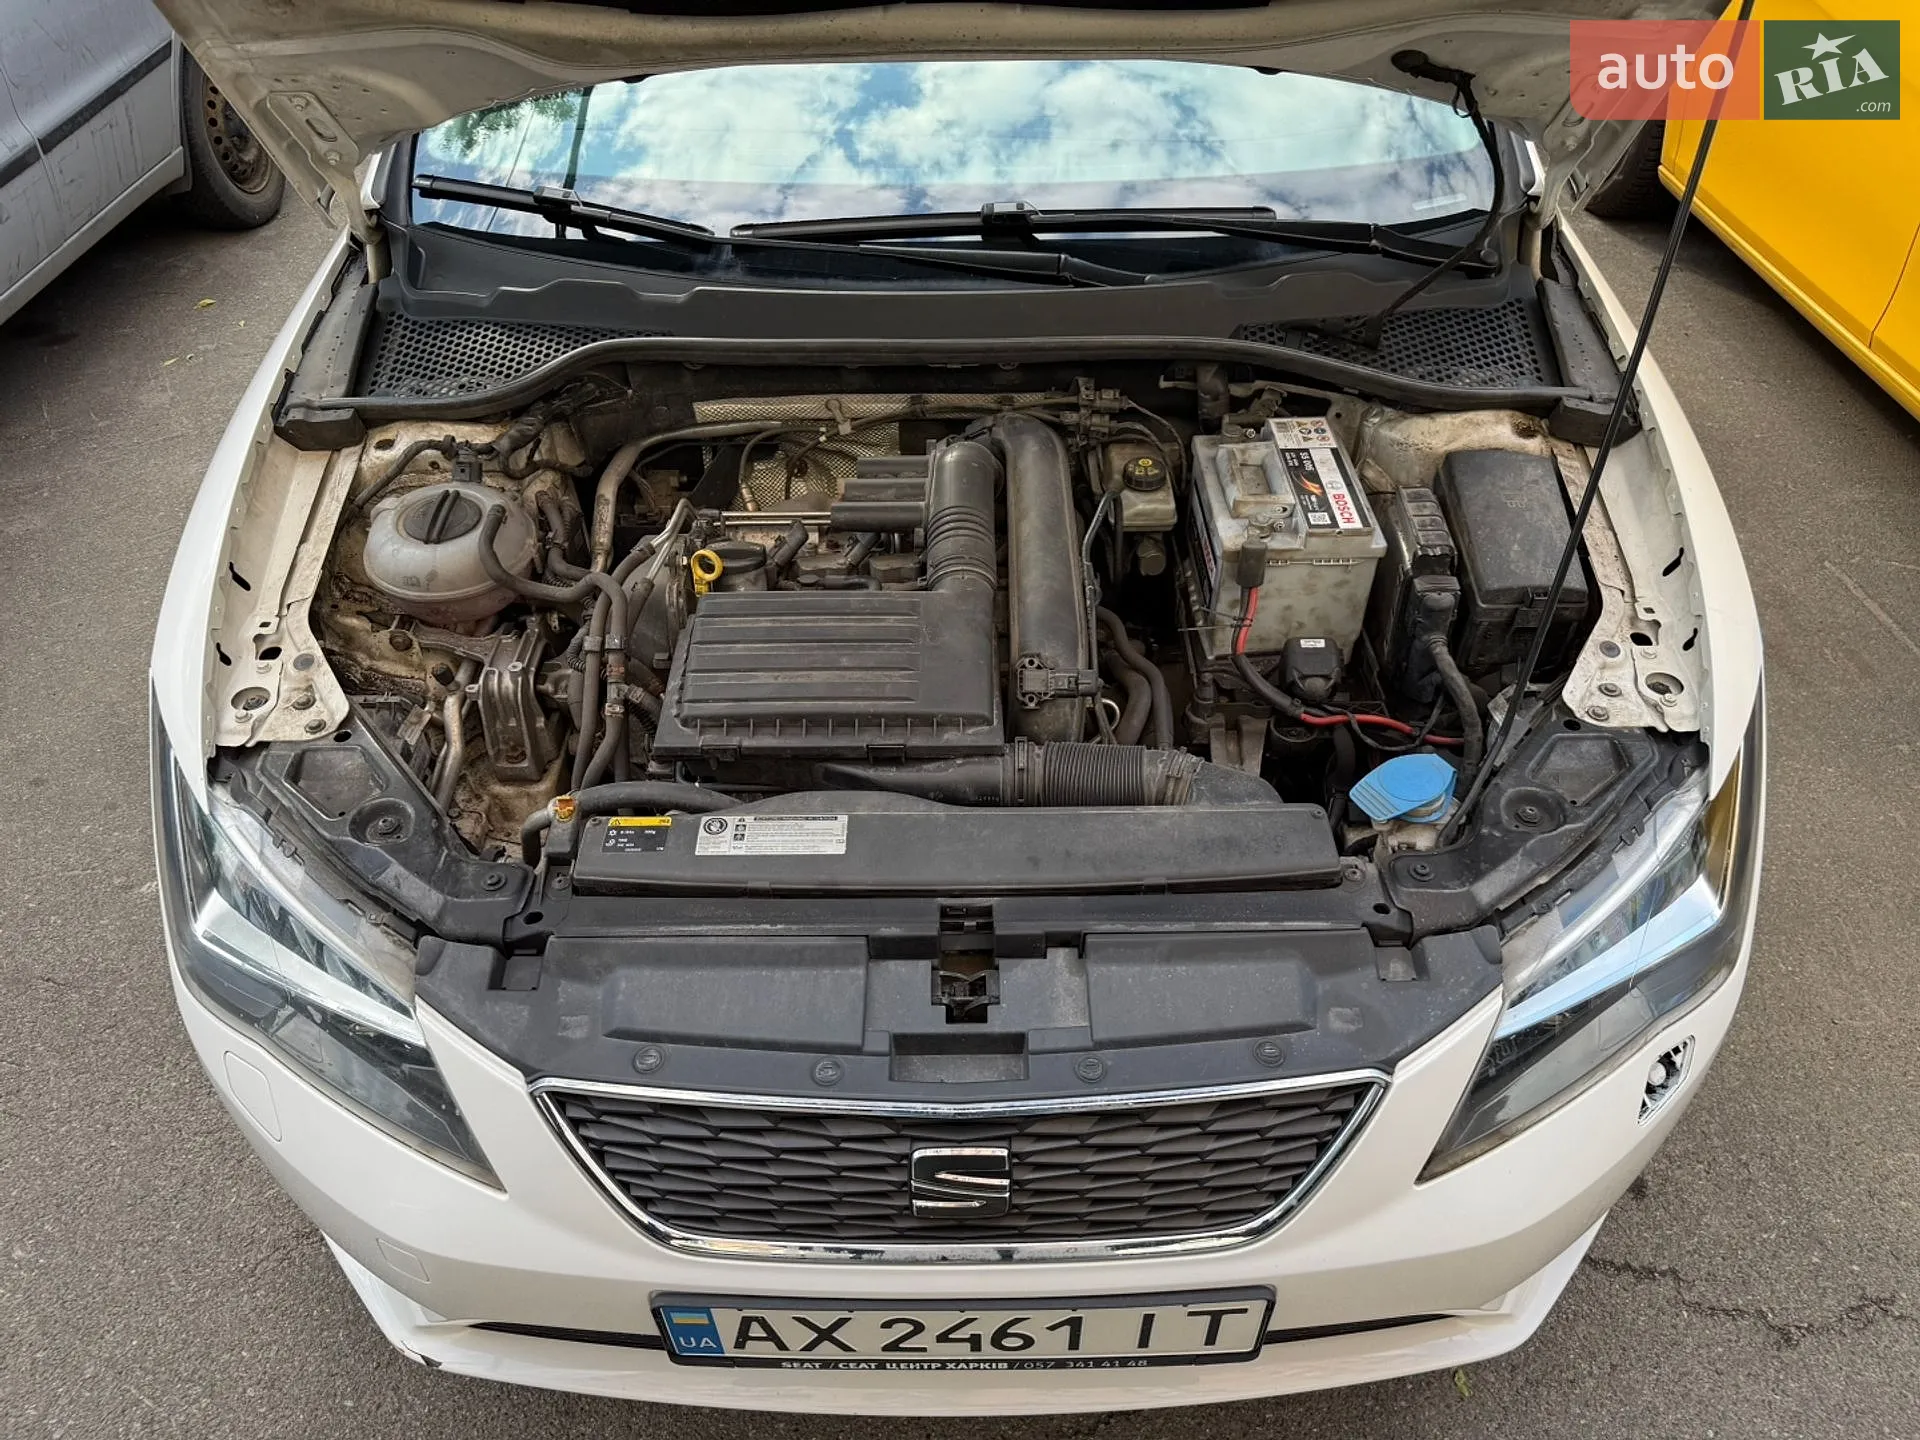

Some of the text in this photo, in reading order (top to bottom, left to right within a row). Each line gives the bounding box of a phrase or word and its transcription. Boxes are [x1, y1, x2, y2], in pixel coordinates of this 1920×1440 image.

[1332, 493, 1356, 524] BOSCH
[678, 1336, 718, 1350] UA
[732, 1315, 857, 1353] AX
[879, 1315, 1084, 1353] 2461
[780, 1361, 822, 1369] SEAT
[885, 1362, 941, 1370] ЦЕНТР
[1023, 1361, 1056, 1369] 057
